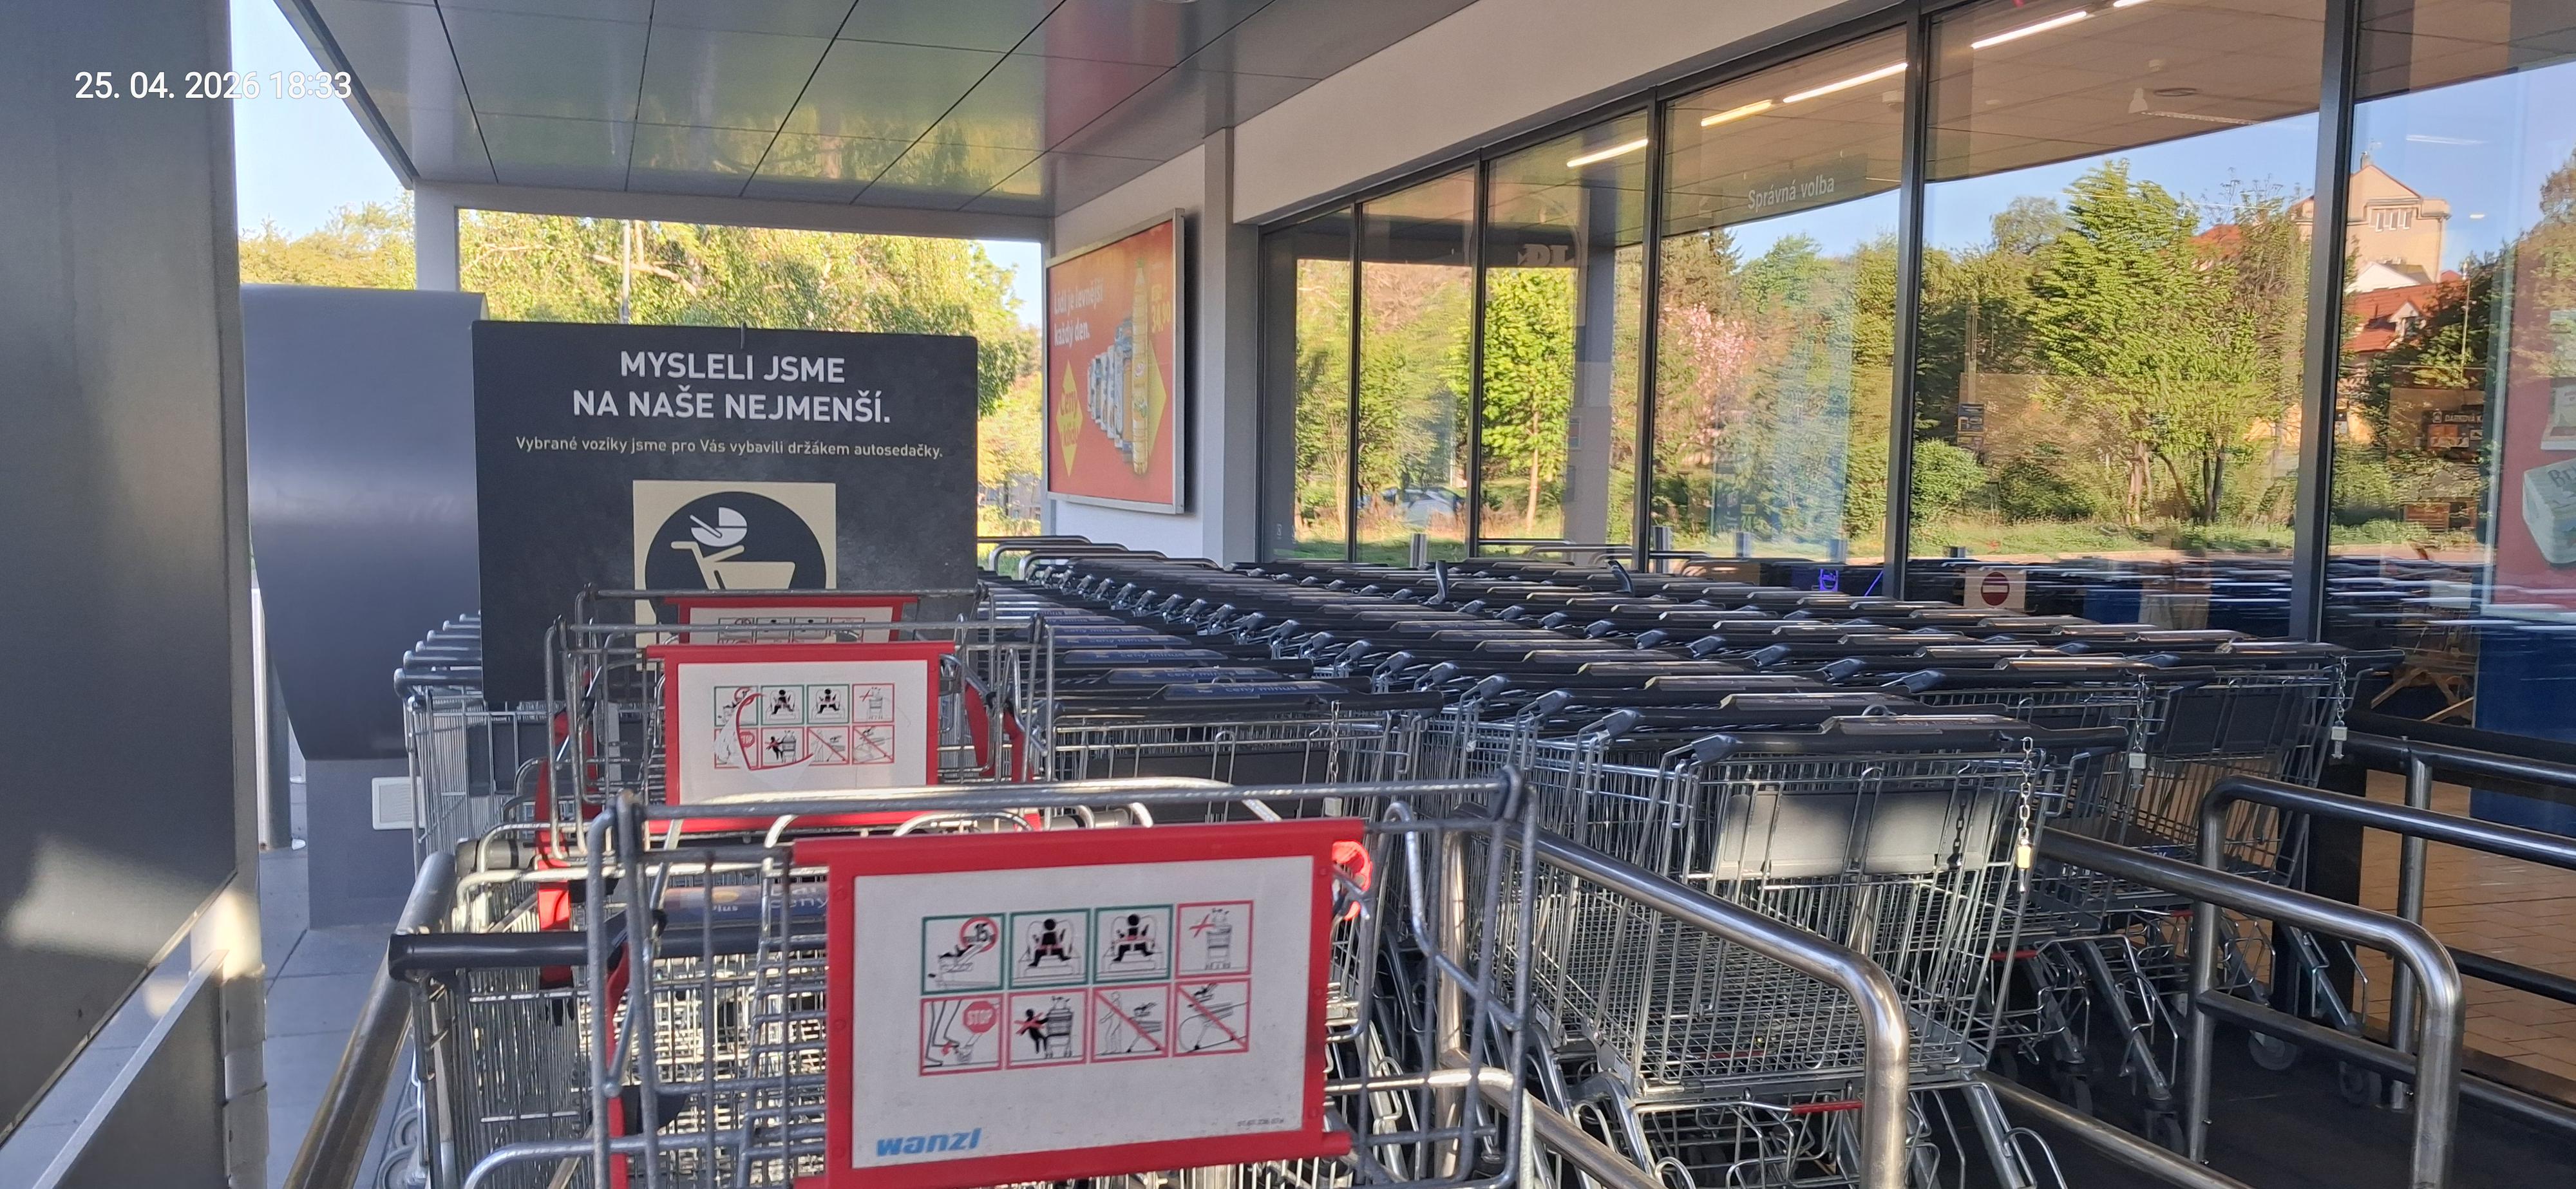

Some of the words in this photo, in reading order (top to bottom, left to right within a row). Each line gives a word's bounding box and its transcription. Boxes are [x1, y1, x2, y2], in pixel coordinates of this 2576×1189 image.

[1748, 179, 1796, 213] Správná
[1801, 174, 1835, 198] volba
[620, 350, 753, 381] MYSLELI
[763, 355, 846, 383] JSME
[573, 389, 619, 416] NA
[629, 384, 714, 418] NAŠE
[725, 389, 891, 423] NEJMENŠÍ.
[516, 436, 578, 453] Vybrané
[582, 437, 627, 454] vozíky
[630, 437, 667, 454] jsme
[671, 440, 696, 454] pro
[699, 438, 726, 453] Vás
[730, 440, 784, 456] vybavili
[788, 440, 849, 455] držákem
[854, 443, 943, 460] autosedačky.
[968, 1009, 992, 1025] STOP
[876, 1127, 982, 1157] wanzl
